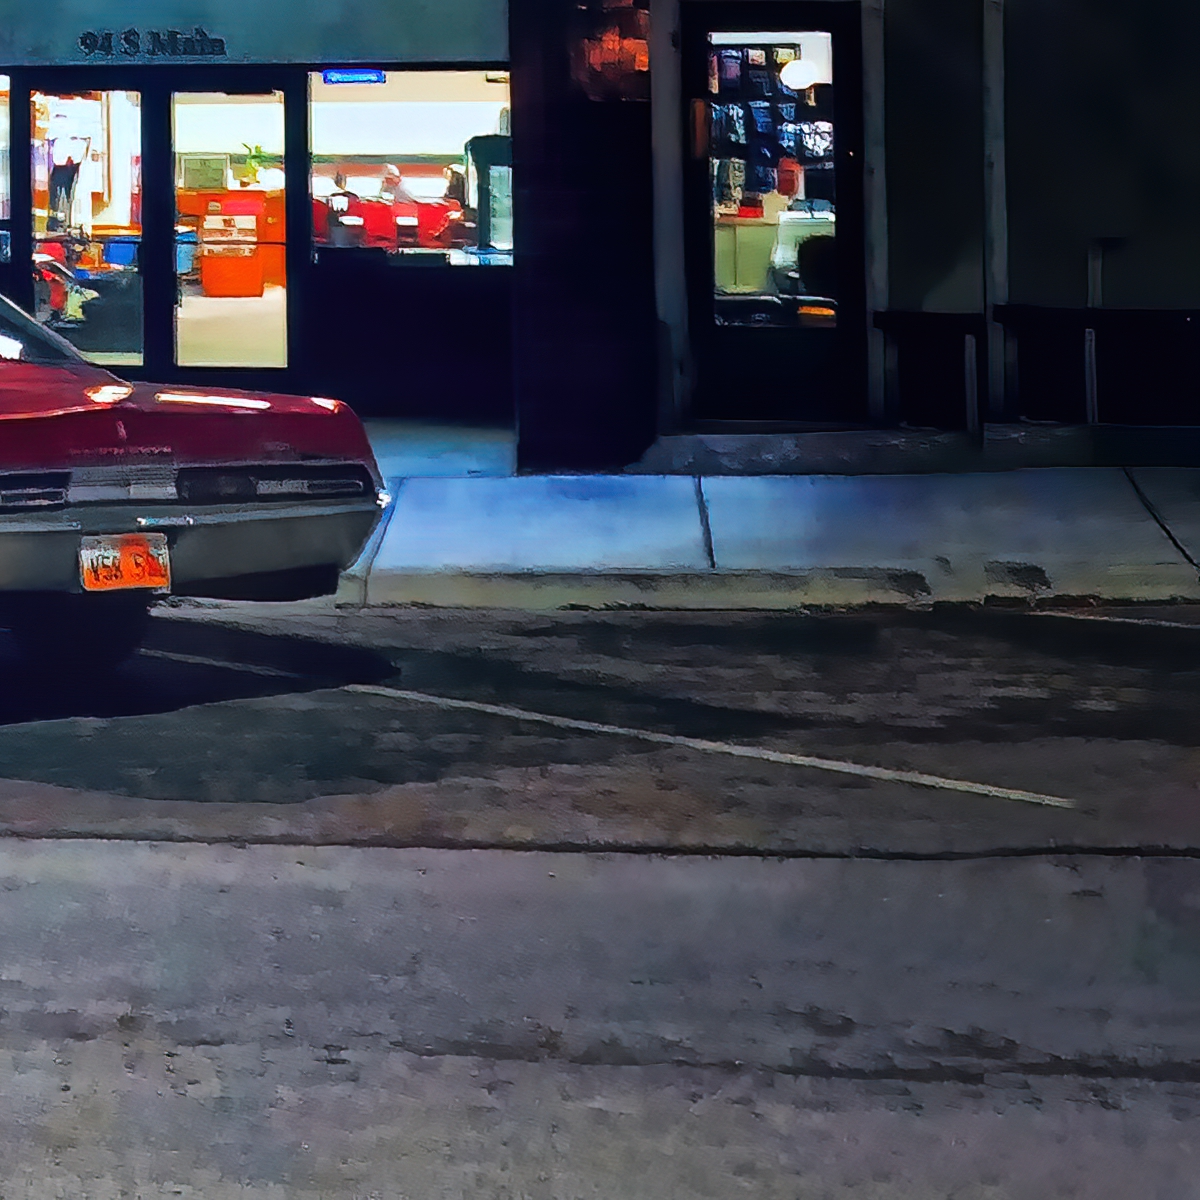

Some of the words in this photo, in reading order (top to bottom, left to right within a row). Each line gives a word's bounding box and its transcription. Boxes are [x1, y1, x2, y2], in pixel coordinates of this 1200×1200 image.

[79, 30, 115, 56] 94
[121, 29, 141, 56] S
[148, 28, 226, 56] Main
